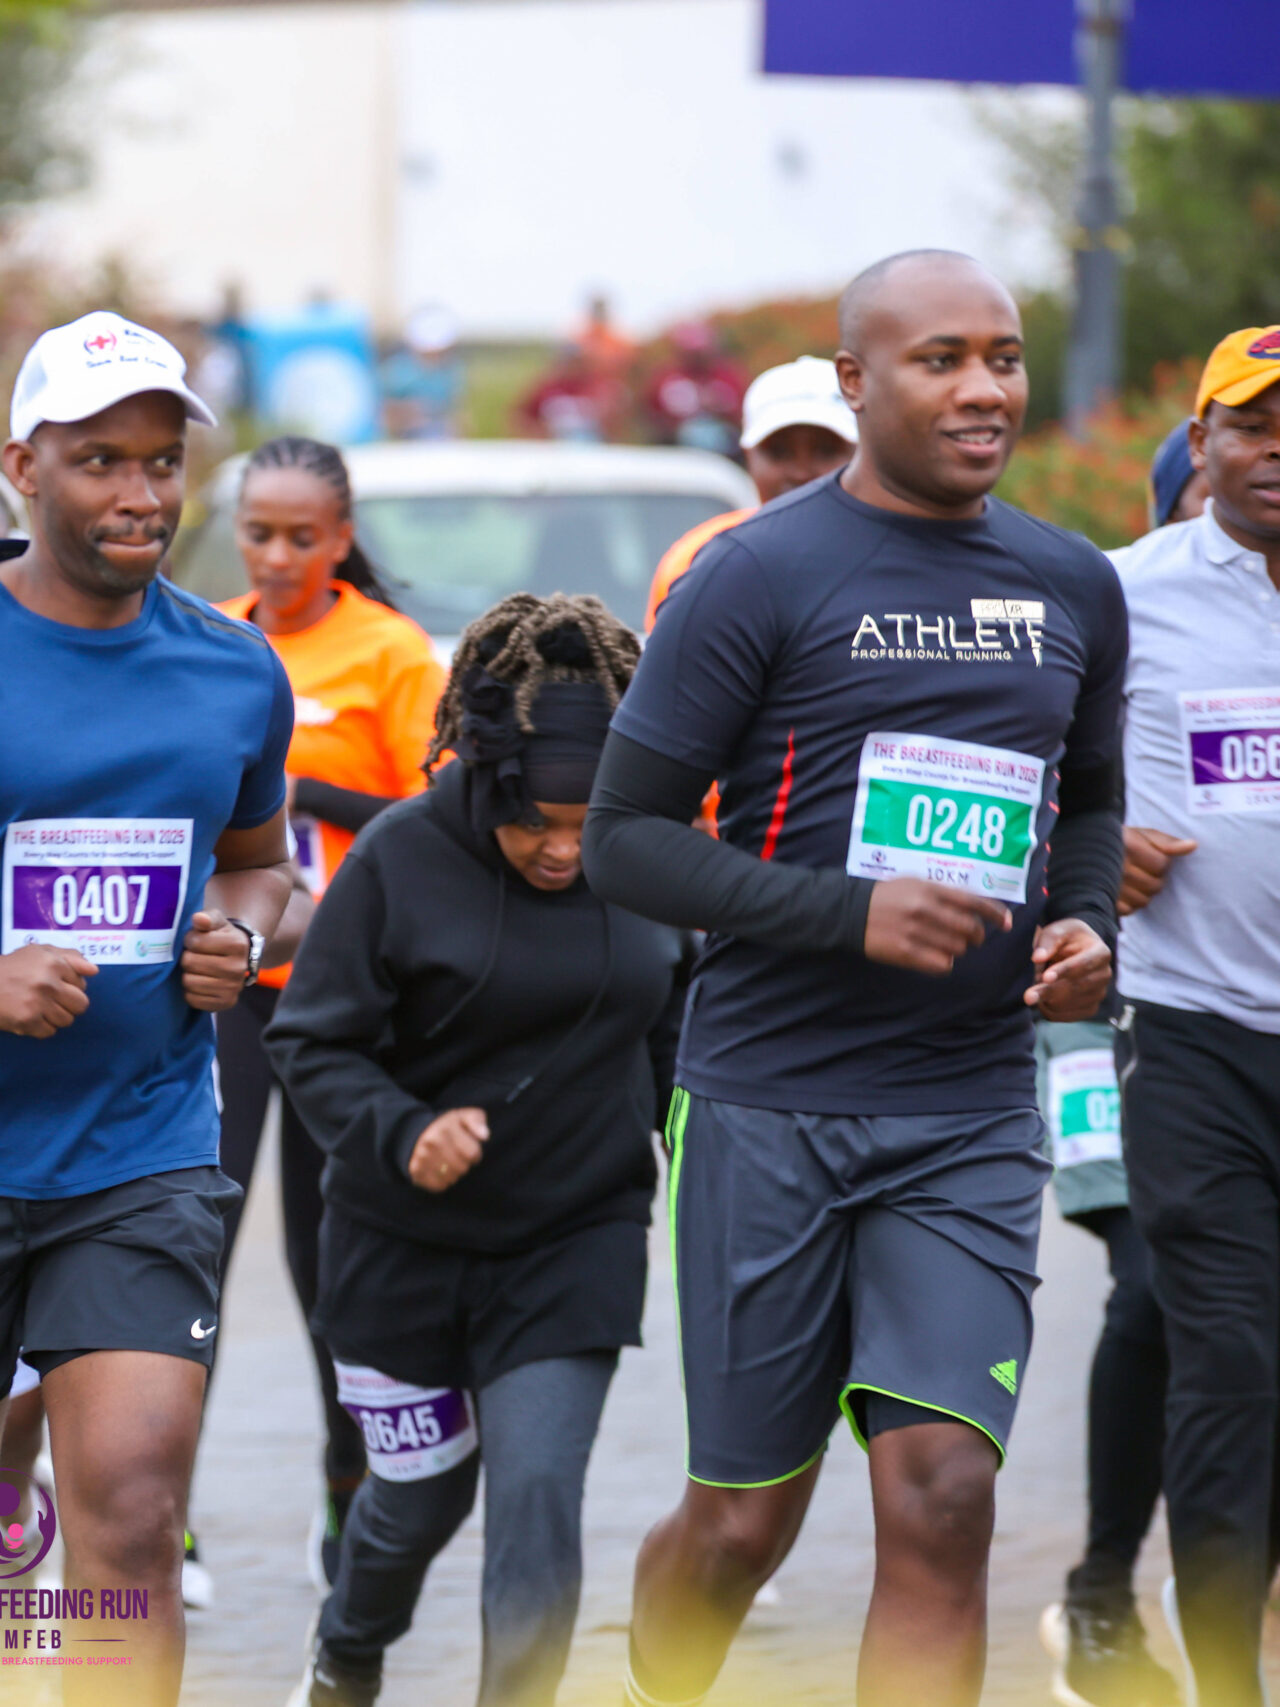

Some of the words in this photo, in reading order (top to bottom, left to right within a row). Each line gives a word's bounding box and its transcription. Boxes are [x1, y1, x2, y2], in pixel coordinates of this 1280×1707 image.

[851, 614, 1045, 667] ATHLETE
[851, 649, 950, 661] PROFESSIONAL
[955, 650, 1013, 661] RUNNING
[873, 743, 896, 759] THE
[901, 746, 991, 774] BREASTFEEDING
[995, 760, 1016, 778] RUN
[1018, 764, 1039, 784] 2025
[14, 830, 35, 845] THE
[40, 829, 130, 844] BREASTFEEDING
[133, 829, 155, 844] RUN
[159, 829, 184, 844] 2025
[906, 794, 1006, 857] 0248
[927, 867, 969, 885] 10KM
[53, 875, 150, 925] 0407
[80, 944, 123, 956] 15KM
[360, 1405, 443, 1453] 0645
